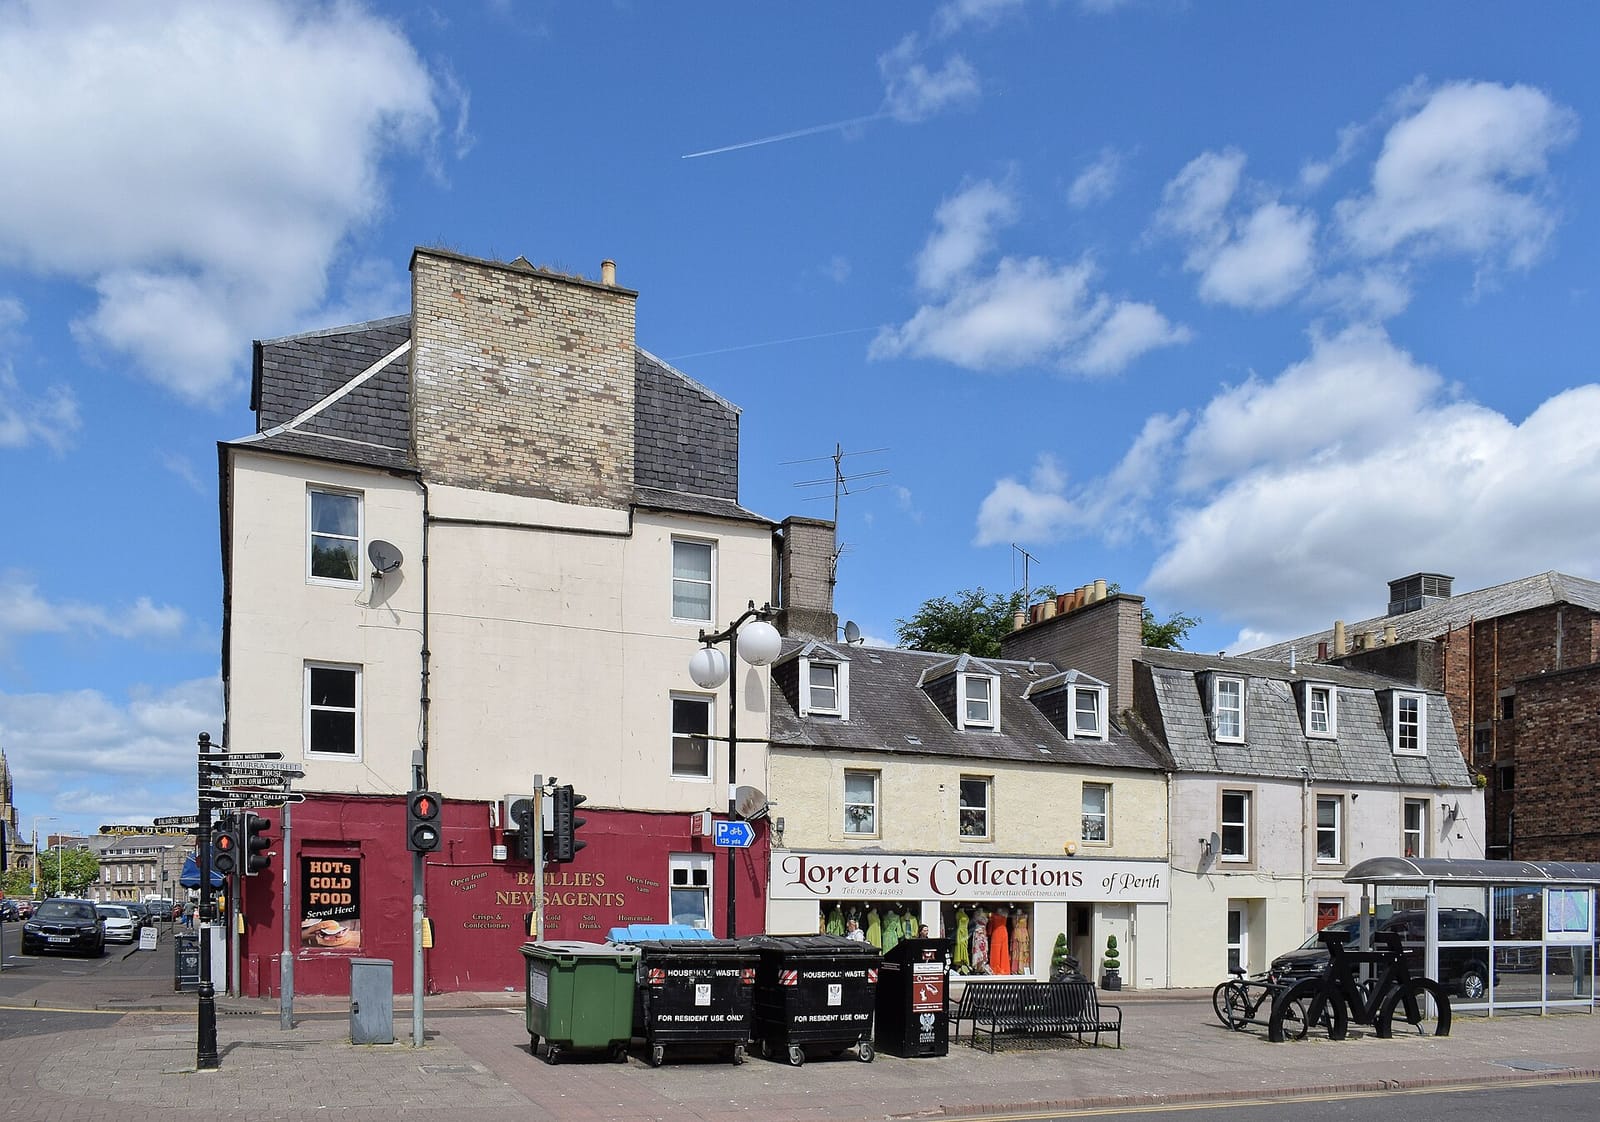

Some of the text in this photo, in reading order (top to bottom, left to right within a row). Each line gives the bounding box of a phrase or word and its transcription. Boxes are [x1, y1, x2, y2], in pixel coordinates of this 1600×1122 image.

[236, 761, 271, 769] MURRAY
[231, 768, 258, 776] PULLAR
[239, 777, 279, 786] INFORMATION
[718, 823, 728, 837] P
[450, 871, 488, 887] Open from
[781, 855, 1160, 896] Loretta's Collections of Perth
[310, 877, 352, 889] COLD
[626, 875, 660, 887] Open from
[310, 892, 352, 905] FOOD
[307, 904, 356, 918] Served Here!
[583, 911, 596, 920] Soft
[472, 912, 494, 921] Crisps
[545, 912, 561, 920] Cold
[618, 913, 654, 921] Homemade
[579, 922, 601, 930] Drinks
[716, 969, 740, 977] WASTE
[844, 970, 866, 978] WASTE
[657, 1014, 673, 1022] FOR
[674, 1014, 709, 1022] RESIDENT
[794, 1015, 808, 1023] FOR
